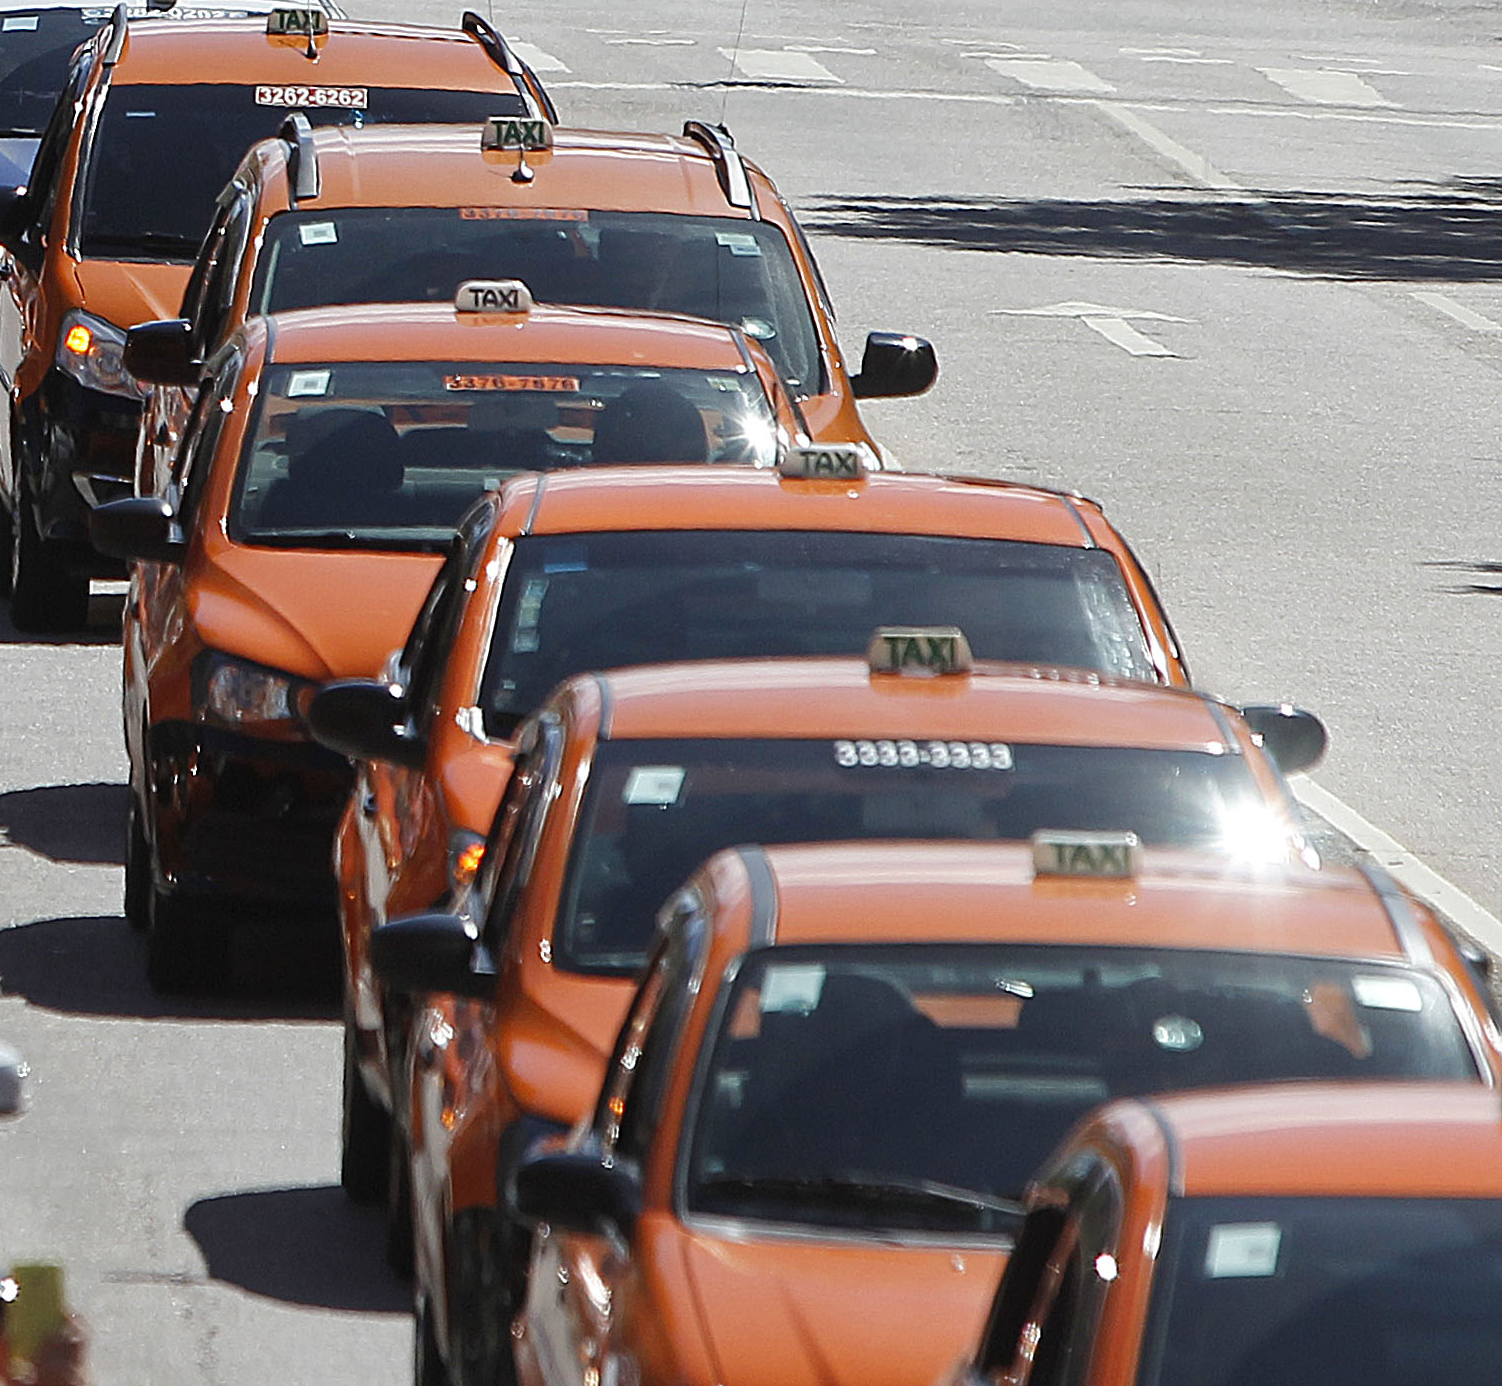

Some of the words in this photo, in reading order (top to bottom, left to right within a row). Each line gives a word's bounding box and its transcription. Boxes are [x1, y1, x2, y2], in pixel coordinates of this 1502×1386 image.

[274, 9, 320, 29] TAXI
[258, 87, 365, 106] 3262-6262
[490, 120, 545, 144] TAXI
[468, 289, 519, 308] TAXI
[800, 451, 859, 476] TAXI
[883, 636, 955, 670] TAXI
[834, 739, 1013, 770] 3333-3333
[1050, 843, 1131, 874] TAXI
